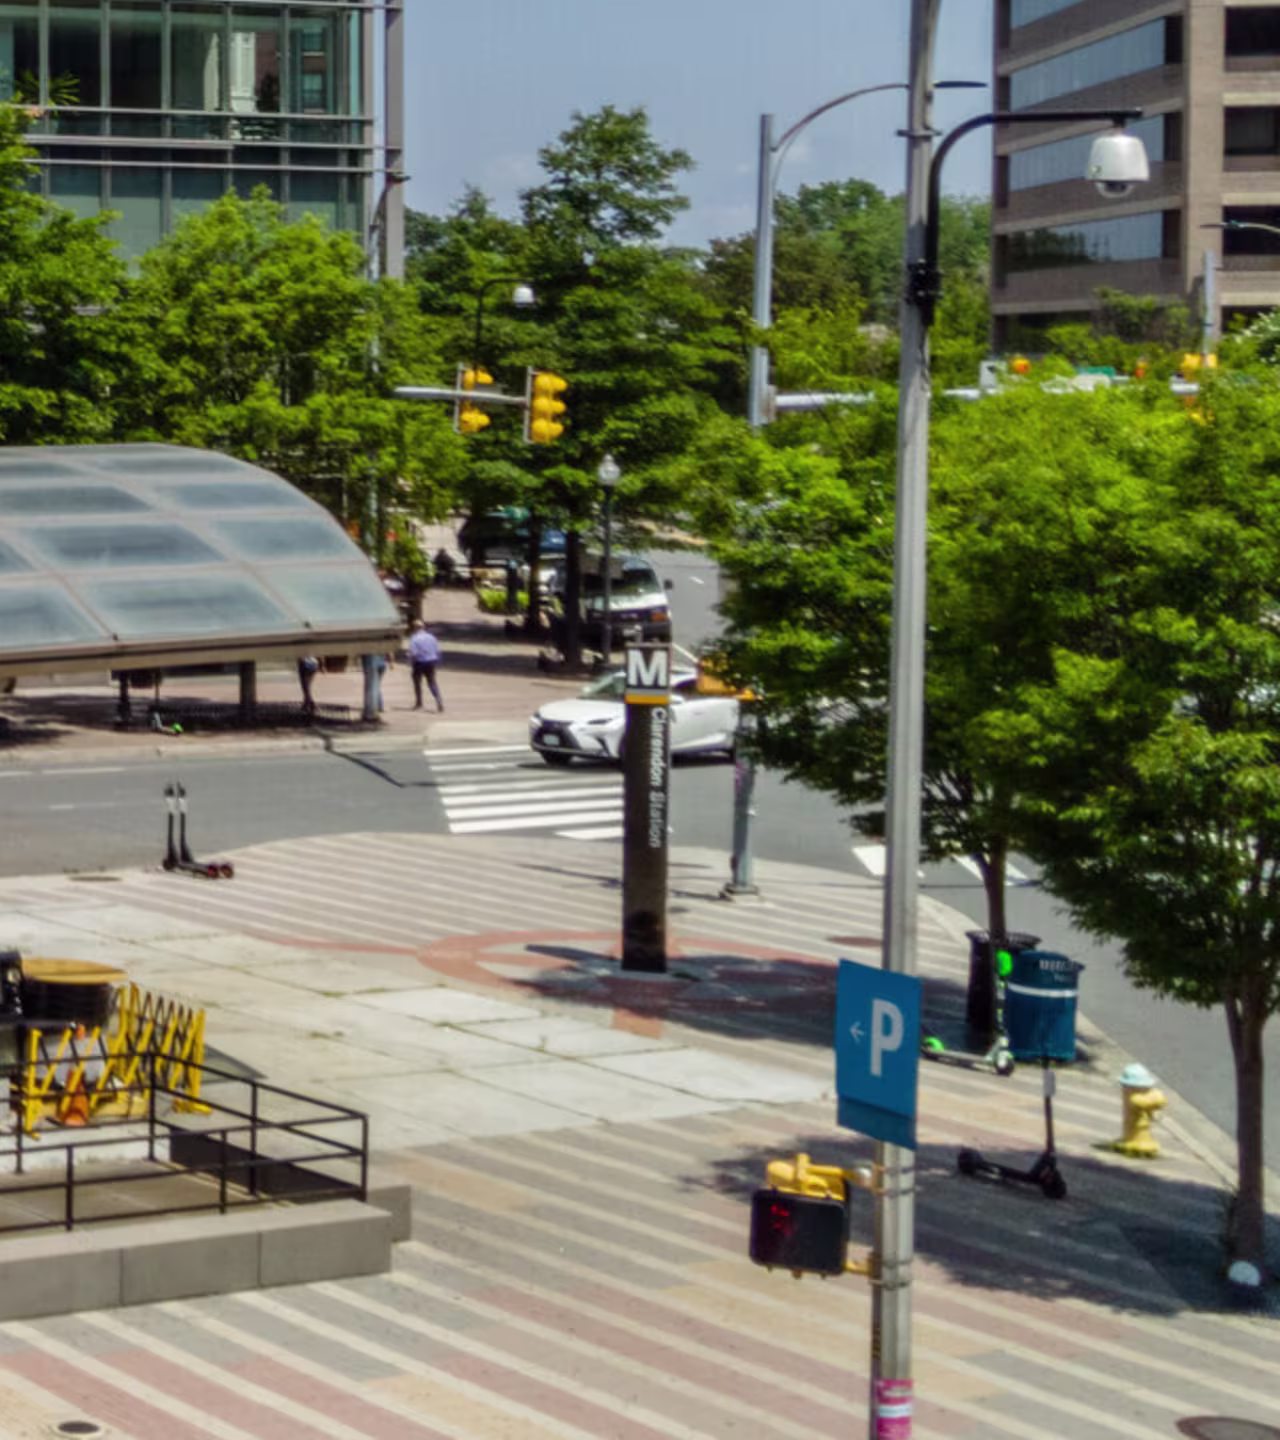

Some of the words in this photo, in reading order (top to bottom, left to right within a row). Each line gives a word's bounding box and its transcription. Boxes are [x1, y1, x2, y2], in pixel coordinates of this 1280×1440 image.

[627, 649, 668, 686] M
[650, 707, 668, 786] Clarendon
[648, 791, 665, 849] Station
[870, 998, 904, 1077] P
